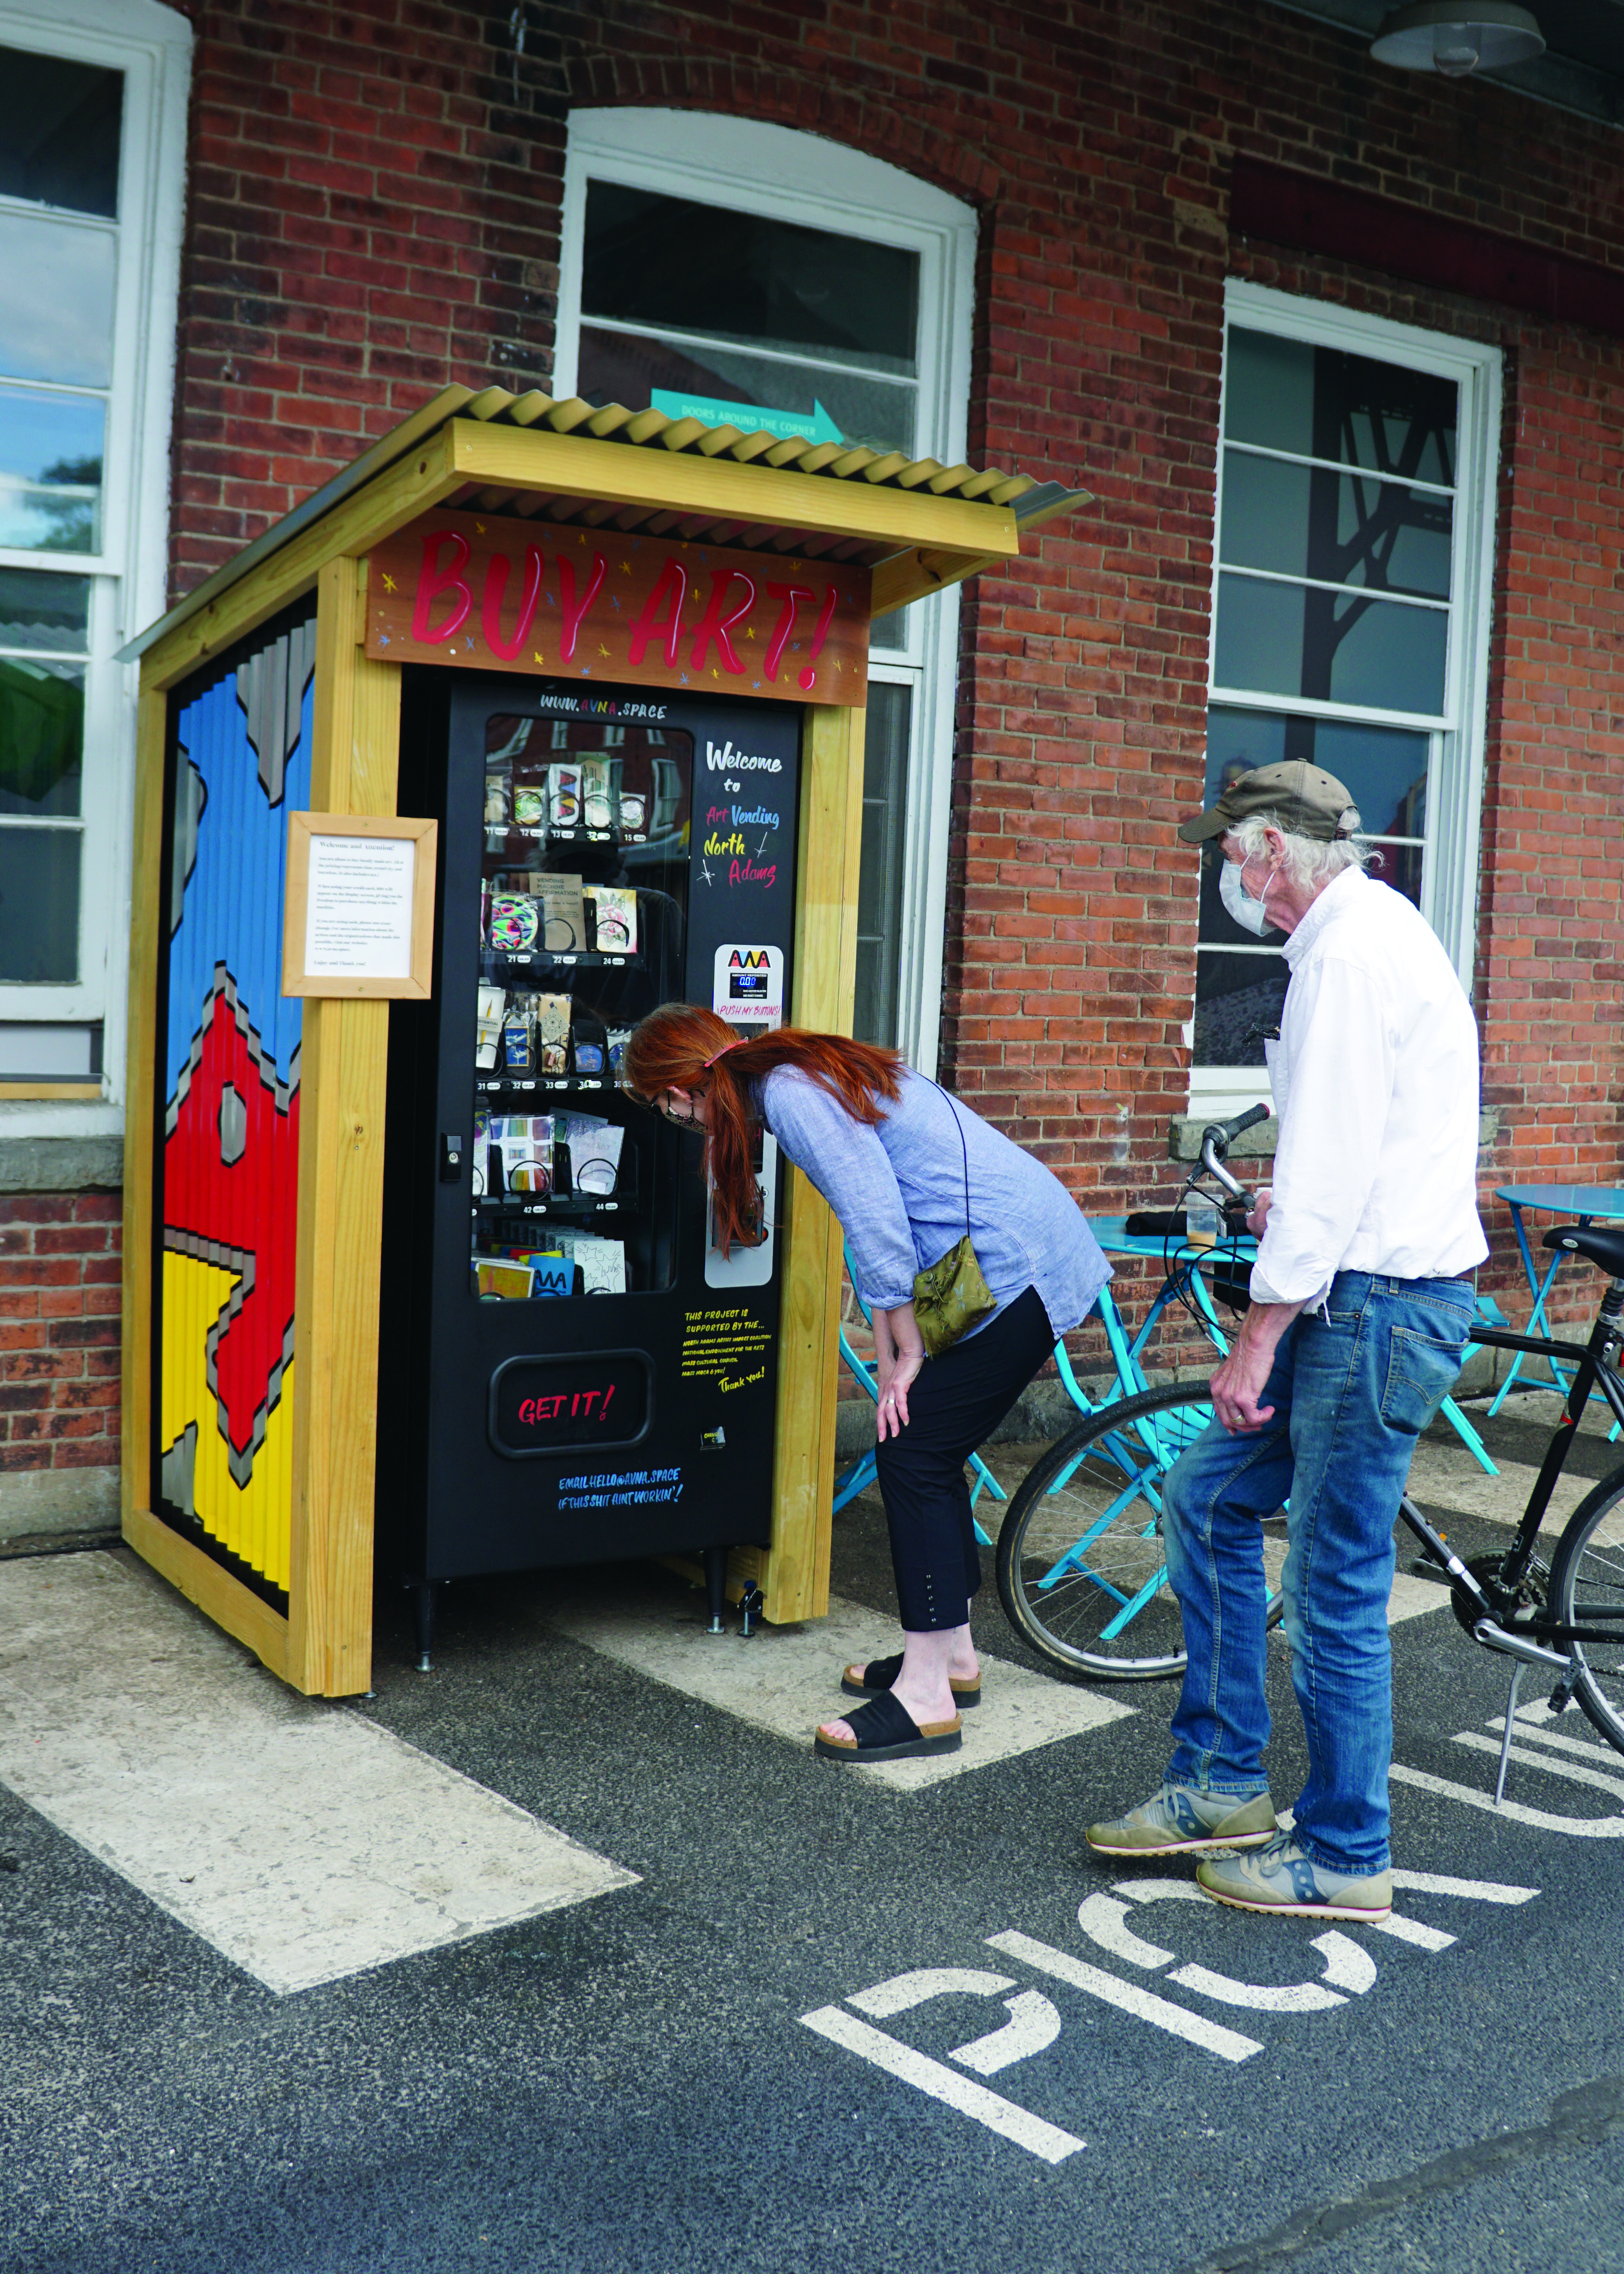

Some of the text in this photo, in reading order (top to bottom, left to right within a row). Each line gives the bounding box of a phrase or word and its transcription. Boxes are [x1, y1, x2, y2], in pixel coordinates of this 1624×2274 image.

[681, 405, 815, 436] DOORS AROUND THE CORNER
[411, 529, 838, 691] BUY ART!
[540, 694, 667, 720] WWW.AVNA.SPACE
[706, 741, 782, 773] Welcome
[723, 778, 740, 793] to
[706, 805, 779, 830] Art Vending
[704, 831, 746, 857] North
[729, 858, 776, 889] Adams
[741, 1006, 753, 1015] MY
[754, 1005, 781, 1016] BUTTONS!
[685, 1311, 702, 1321] THIS
[705, 1309, 739, 1320] PROJECT
[686, 1321, 764, 1333] SUPPORTED BY THE...
[718, 1377, 745, 1393] Thank
[518, 1395, 567, 1426] GET
[559, 1468, 681, 1489] EMAIL HELLO@AVNA.SPACE
[558, 1497, 568, 1511] IF
[568, 1495, 589, 1509] THIS
[590, 1494, 611, 1506] SHIT
[612, 1492, 634, 1505] AINT
